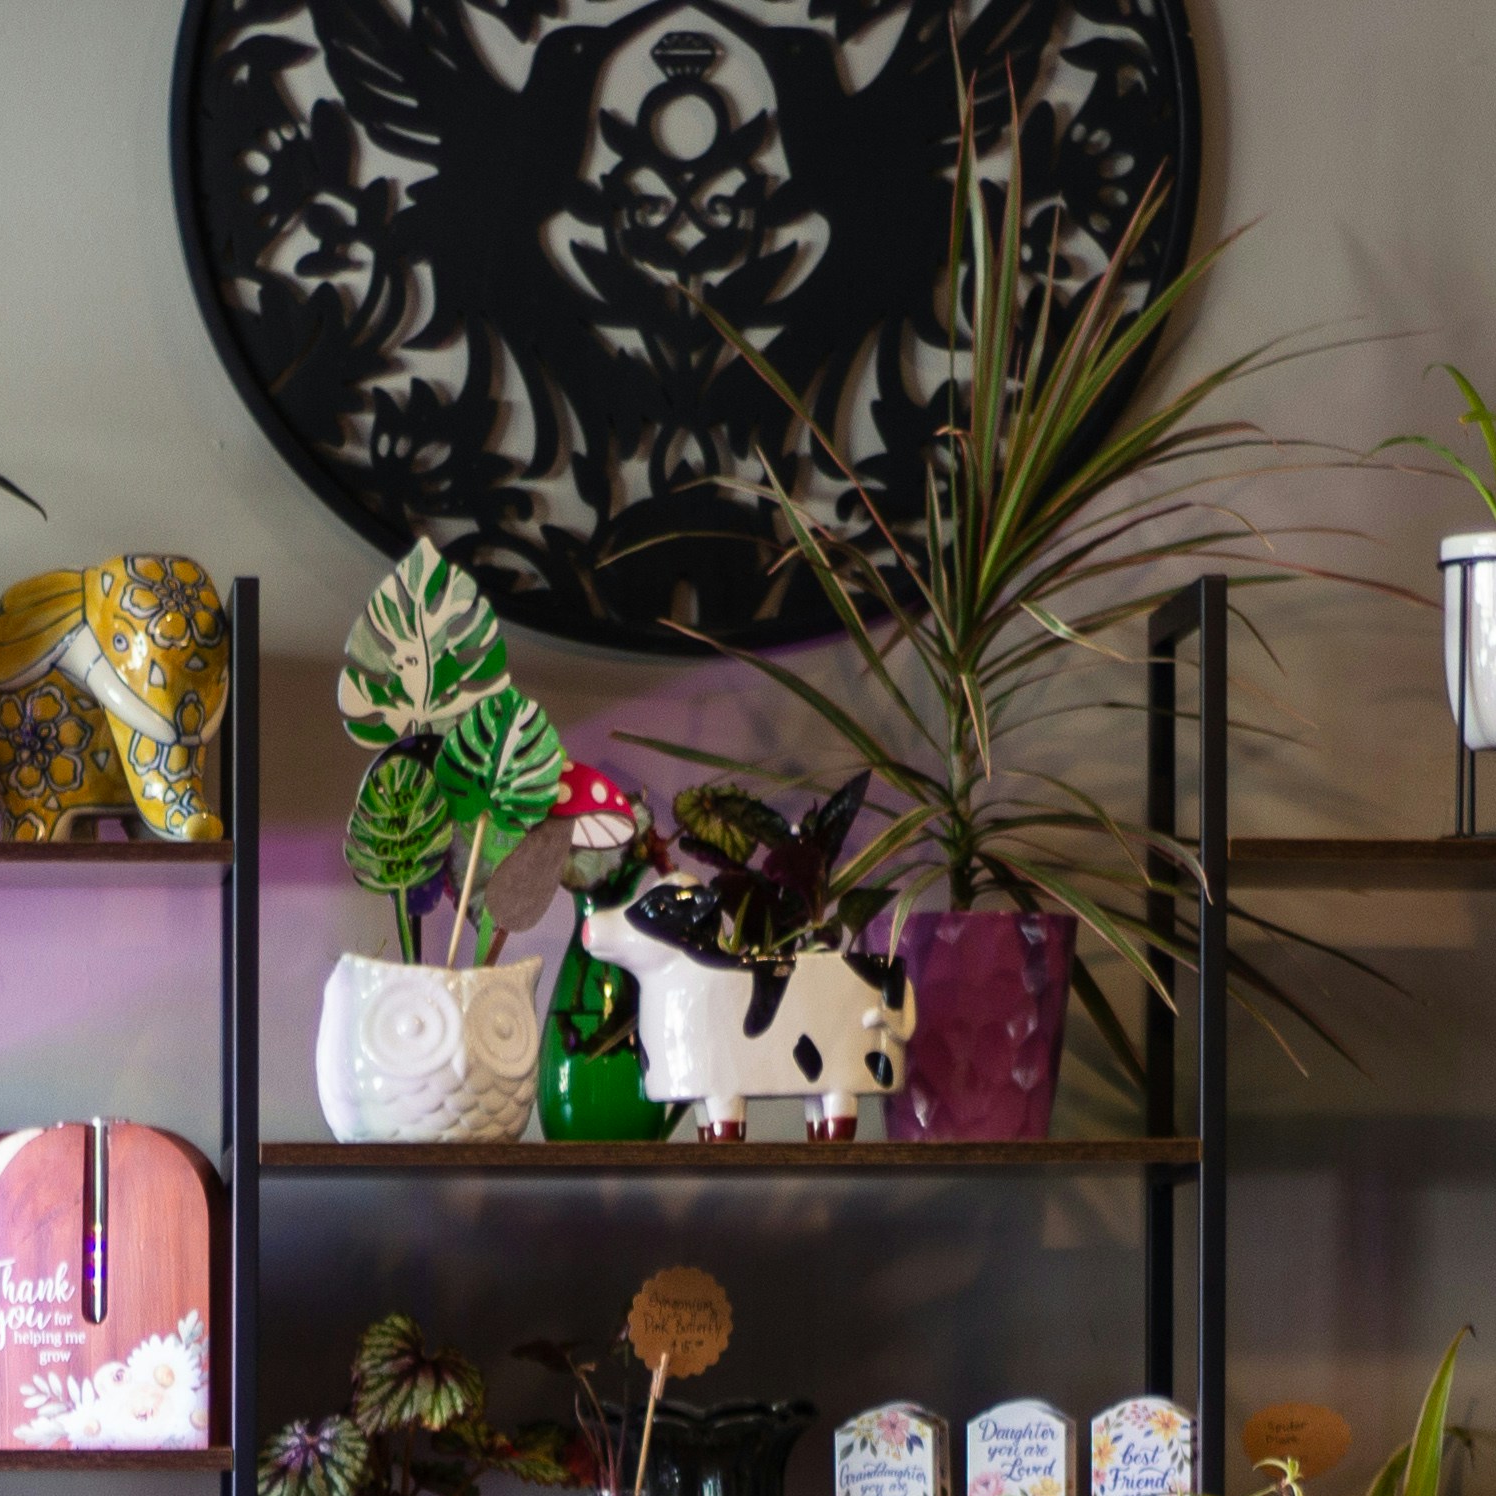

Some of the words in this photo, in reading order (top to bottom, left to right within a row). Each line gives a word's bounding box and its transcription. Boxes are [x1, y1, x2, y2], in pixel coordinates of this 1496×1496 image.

[53, 1311, 73, 1326] for
[13, 1329, 62, 1347] helping
[65, 1332, 86, 1345] me
[39, 1351, 71, 1366] grow
[978, 1418, 1058, 1448] Daughter
[987, 1444, 1020, 1461] you
[1023, 1445, 1049, 1457] are
[1121, 1443, 1160, 1466] best
[839, 1461, 927, 1489] Granddaughter
[1000, 1457, 1056, 1481] Loved
[1108, 1466, 1176, 1492] Friend
